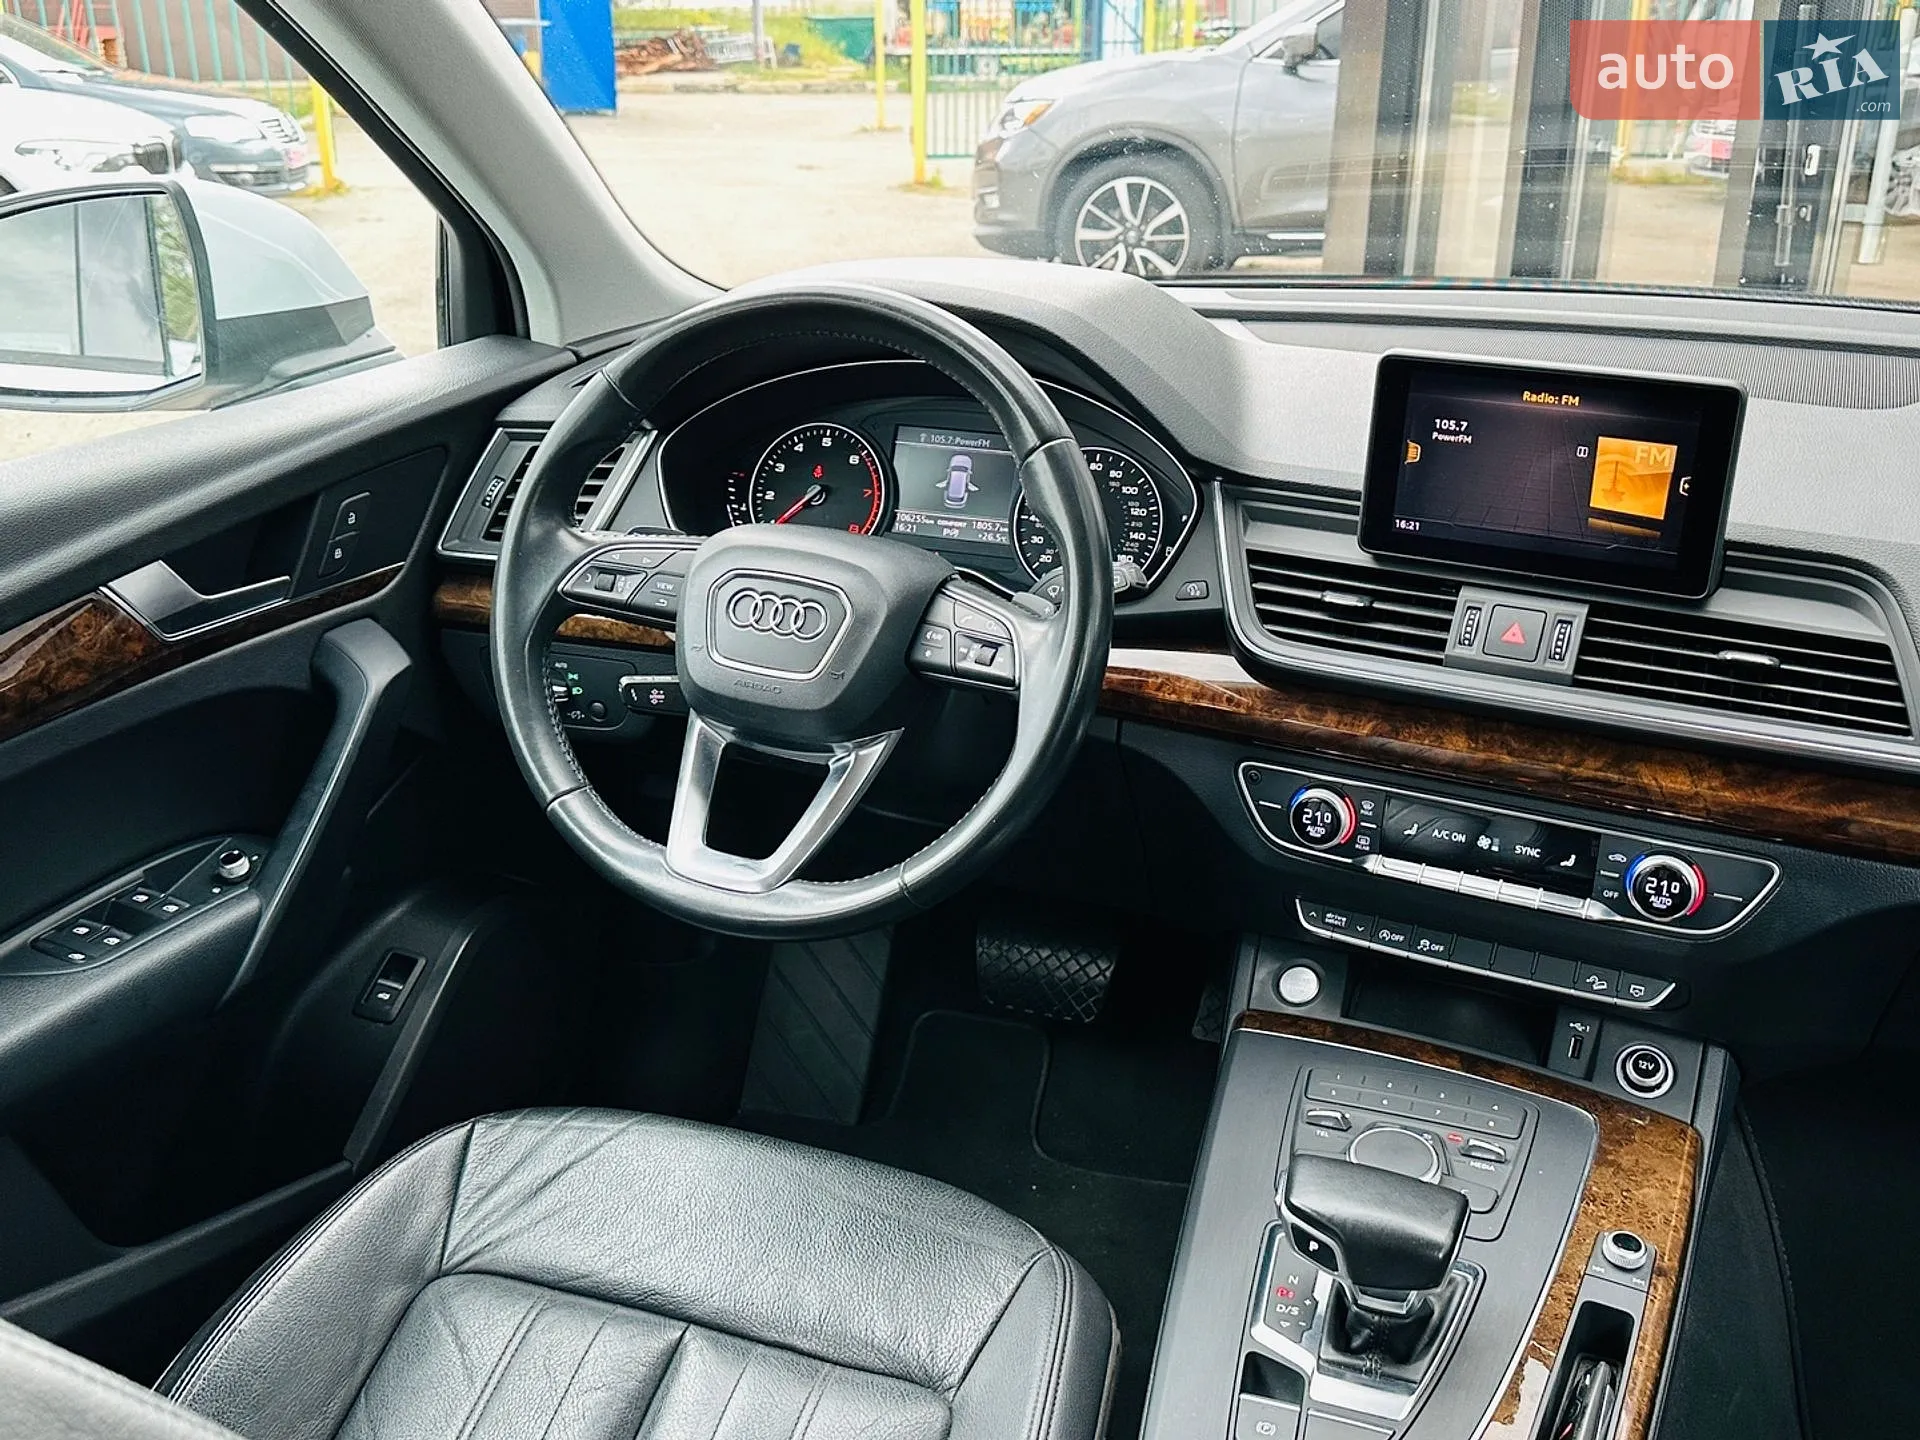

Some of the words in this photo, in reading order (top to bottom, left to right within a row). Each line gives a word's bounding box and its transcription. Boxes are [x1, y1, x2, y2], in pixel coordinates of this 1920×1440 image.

[1522, 391, 1559, 405] Radio:
[1561, 395, 1580, 406] FM
[1435, 418, 1469, 432] 105.7
[822, 437, 832, 447] 5
[1432, 431, 1472, 444] PowerFM
[794, 443, 804, 452] 4
[849, 455, 860, 464] 6
[1633, 445, 1671, 467] FM
[775, 463, 785, 472] 3
[764, 490, 775, 500] 2
[863, 489, 872, 498] 7
[1122, 486, 1138, 495] 100
[1130, 507, 1147, 516] 120
[895, 523, 916, 533] 16:21
[1394, 519, 1420, 531] 16:21
[1031, 536, 1044, 544] 30
[1129, 532, 1146, 540] 140
[656, 582, 674, 591] VIEW
[1306, 825, 1326, 835] AUTO
[1432, 828, 1450, 840] A/C
[1451, 832, 1466, 843] ON
[1514, 845, 1541, 858] SYNC
[1603, 889, 1619, 900] OFF
[1649, 895, 1673, 906] AUTO
[1325, 912, 1347, 921] drive
[1325, 918, 1346, 927] select
[1391, 934, 1405, 942] OFF
[1430, 944, 1444, 952] OFF
[1638, 1060, 1655, 1071] 12V
[1315, 1130, 1329, 1138] TEL
[1470, 1161, 1496, 1172] MEDIA
[1308, 1241, 1319, 1252] P
[1288, 1275, 1299, 1285] N
[1276, 1304, 1300, 1316] D/S
